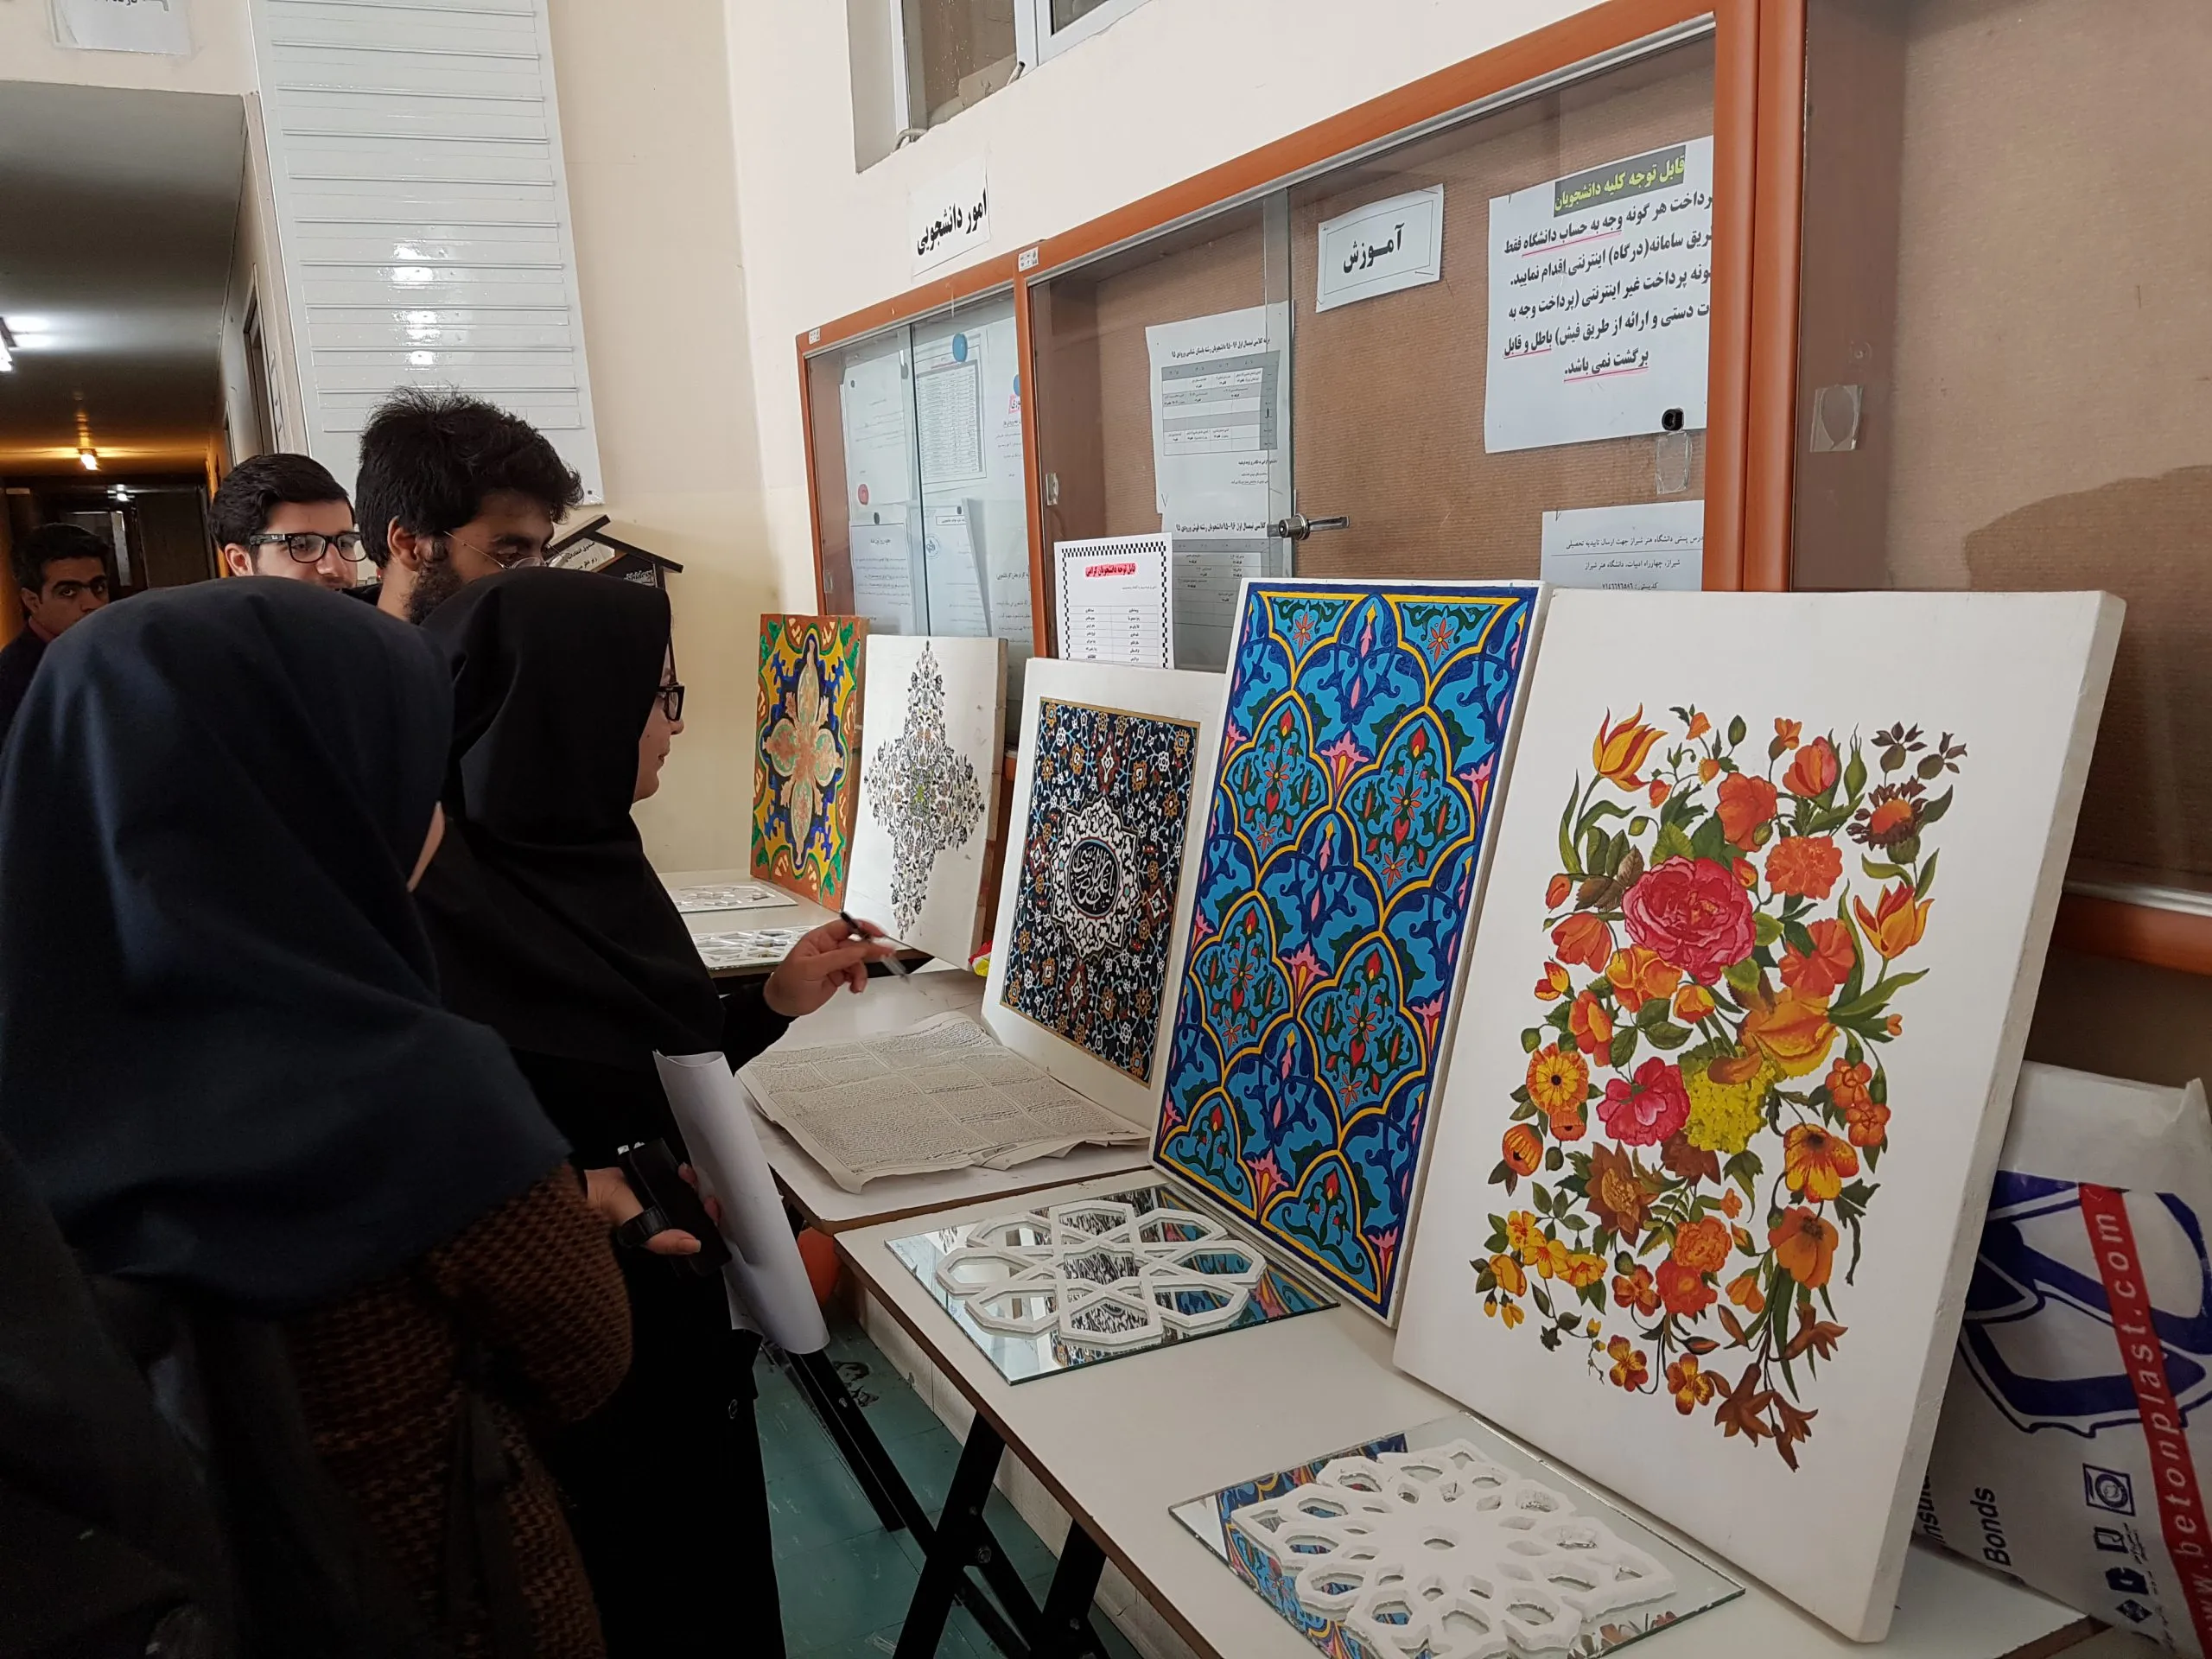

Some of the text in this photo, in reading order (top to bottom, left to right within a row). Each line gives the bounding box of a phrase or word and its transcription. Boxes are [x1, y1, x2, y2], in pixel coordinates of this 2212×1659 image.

[1554, 153, 1686, 212] قابل توجه کلیه دانشجویان
[917, 187, 988, 256] امور دانشجویی
[1602, 215, 1623, 231] وجه
[1626, 202, 1650, 226] گونه
[1652, 202, 1667, 222] هر
[1559, 222, 1587, 244] حساب
[1590, 219, 1599, 234] به
[1343, 222, 1405, 274] آموزش
[1503, 235, 1522, 254] فقط
[1523, 228, 1557, 249] دانشگاه
[1541, 257, 1567, 283] اقدام
[1567, 248, 1606, 276] اینترنتی
[1643, 269, 1688, 290] پرداخت
[1690, 264, 1712, 284] ونه
[1581, 279, 1621, 307] اینترنتی
[1622, 276, 1640, 299] غیر
[1509, 307, 1516, 321] به
[1518, 303, 1536, 319] وجه
[1624, 309, 1649, 332] ارائه
[1651, 315, 1658, 329] و
[1660, 305, 1694, 327] دستی
[1582, 317, 1610, 341] طریق
[1611, 315, 1623, 336] از
[1503, 334, 1522, 356] قابل
[1523, 340, 1529, 353] و
[1530, 329, 1553, 351] باطل
[1592, 352, 1611, 374] نمی
[1613, 347, 1649, 367] برگشت
[1630, 537, 1643, 546] شیراز
[1654, 534, 1673, 543] دانشگاه
[1607, 559, 1624, 568] دانشگاه
[2095, 1213, 2212, 1634] ww.betonplast.com
[1970, 1486, 2012, 1567] Bonds
